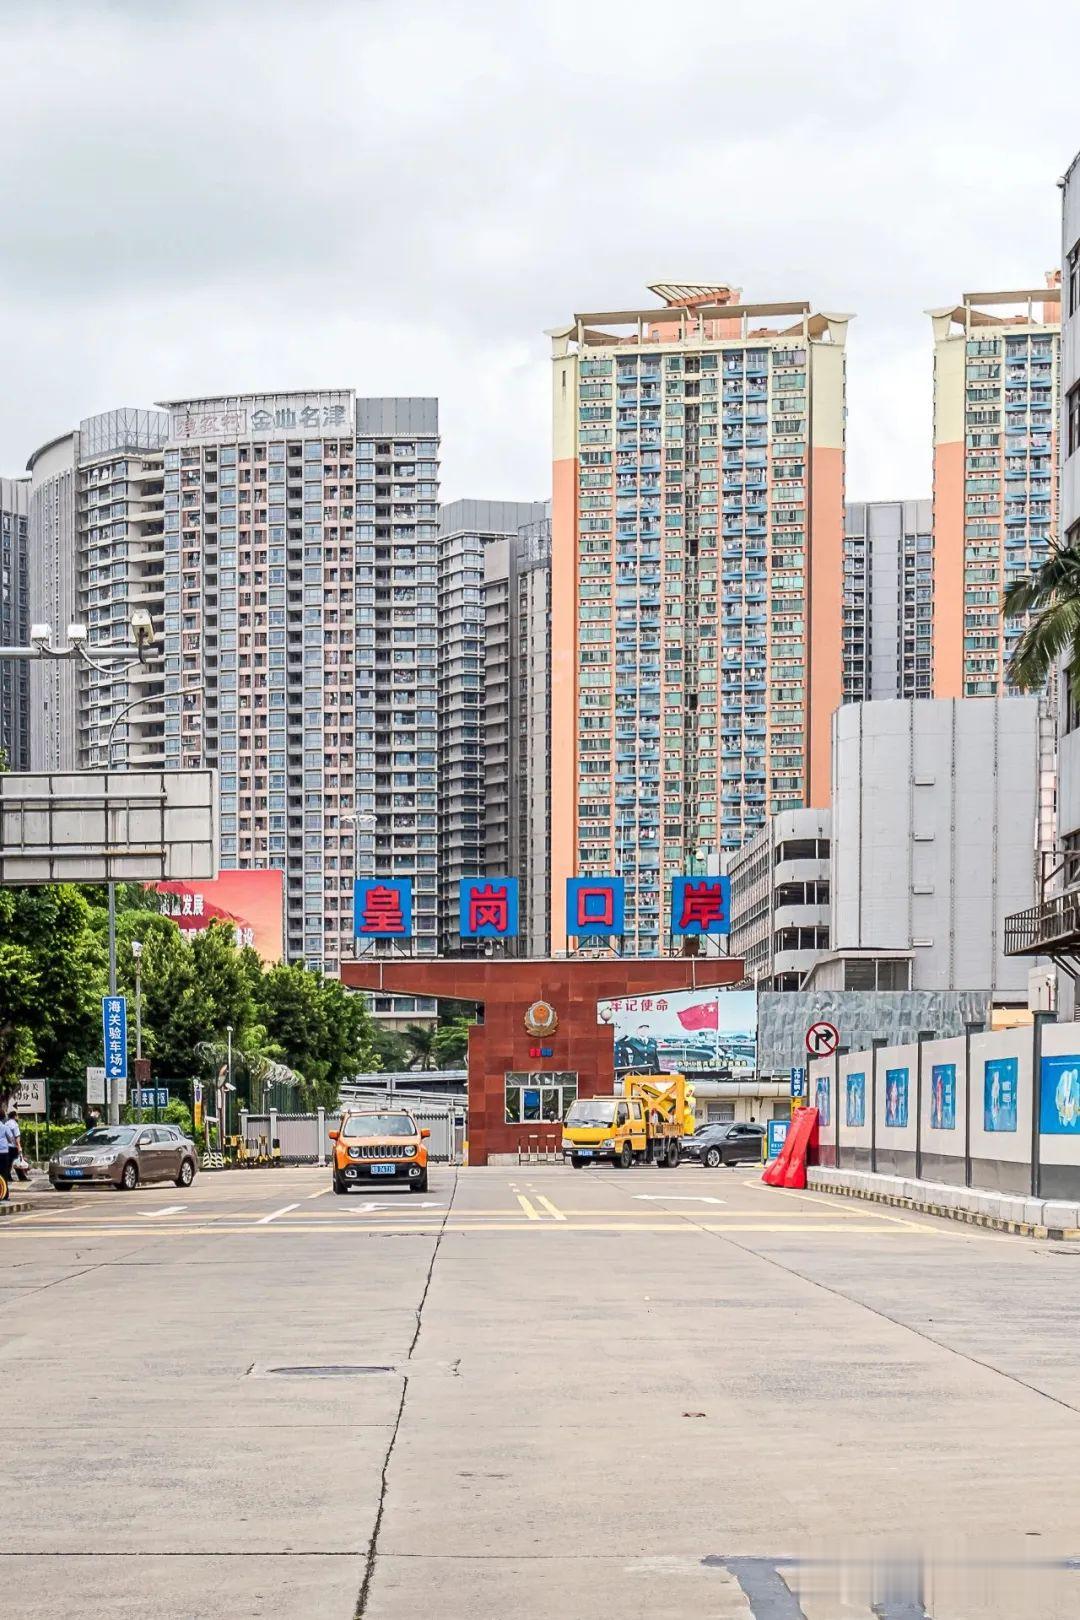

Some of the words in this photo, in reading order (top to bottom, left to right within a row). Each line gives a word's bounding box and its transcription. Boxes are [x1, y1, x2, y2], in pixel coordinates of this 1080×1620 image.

[251, 404, 347, 432] 金地名津
[360, 882, 724, 933] 皇岗口岸
[610, 999, 669, 1012] 牢记使命
[108, 1001, 123, 1066] 海关验车场
